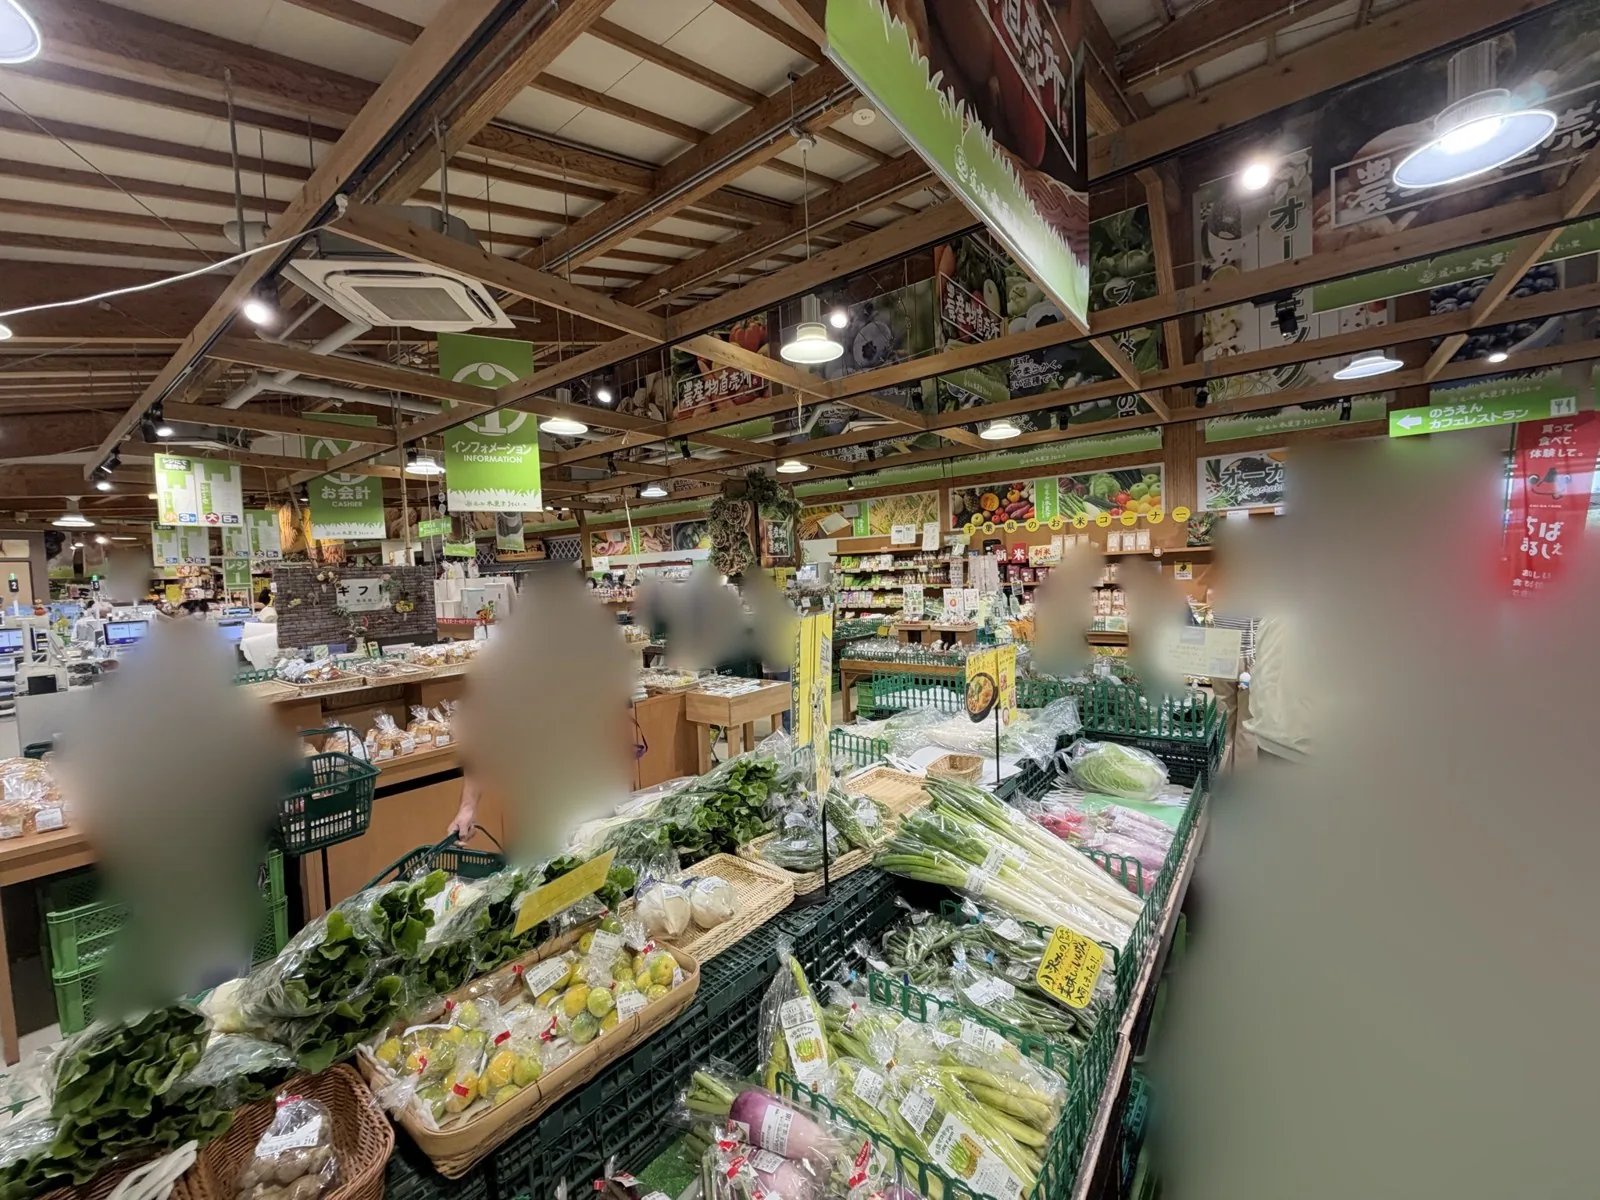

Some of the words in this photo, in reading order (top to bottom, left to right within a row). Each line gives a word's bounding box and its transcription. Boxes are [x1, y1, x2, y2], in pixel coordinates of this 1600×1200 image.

[1429, 403, 1483, 419] のうえん
[1429, 408, 1529, 430] カフェレストラン
[1541, 423, 1578, 434] 買って、
[1538, 435, 1577, 446] 食べて、
[452, 440, 533, 455] インフォメーション
[1529, 448, 1584, 459] 体験して。
[463, 454, 523, 464] INFORMATION
[321, 486, 371, 500] お会計
[1526, 516, 1564, 542] ちば
[225, 560, 248, 570] レジ
